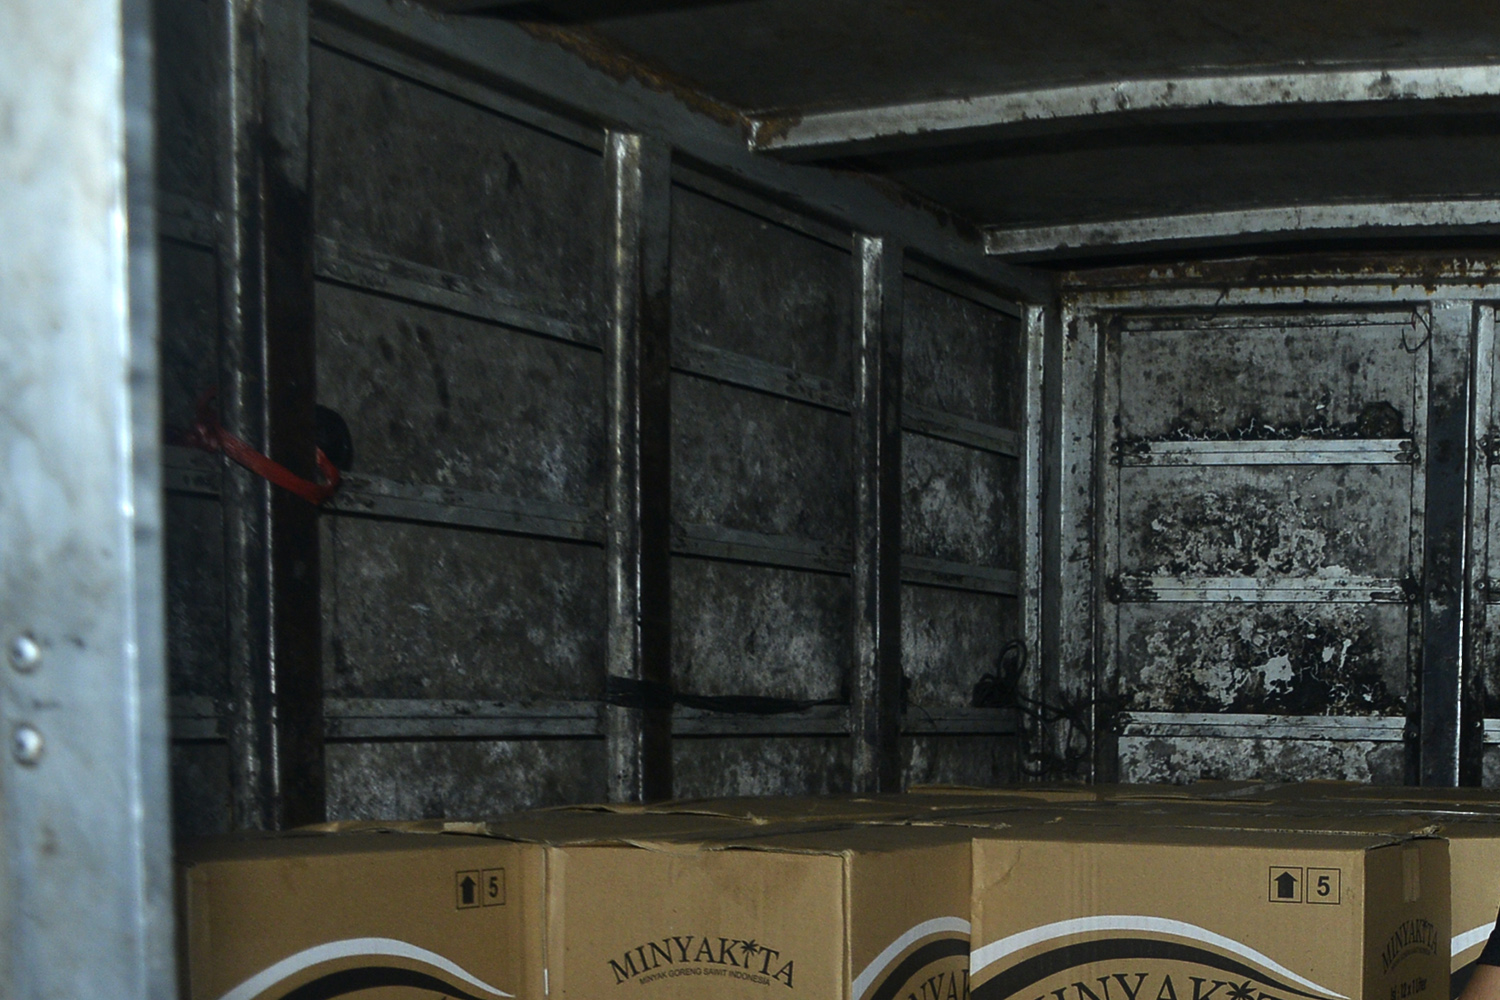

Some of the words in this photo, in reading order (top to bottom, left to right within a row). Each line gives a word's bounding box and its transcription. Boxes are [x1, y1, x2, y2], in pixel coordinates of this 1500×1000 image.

[489, 875, 499, 899] 5
[1316, 876, 1331, 897] 5
[607, 935, 794, 989] MINYAKITA
[639, 972, 668, 986] MINYAK
[668, 967, 702, 979] GORENG
[703, 967, 728, 977] SAWIT
[728, 969, 771, 987] INDONESIA
